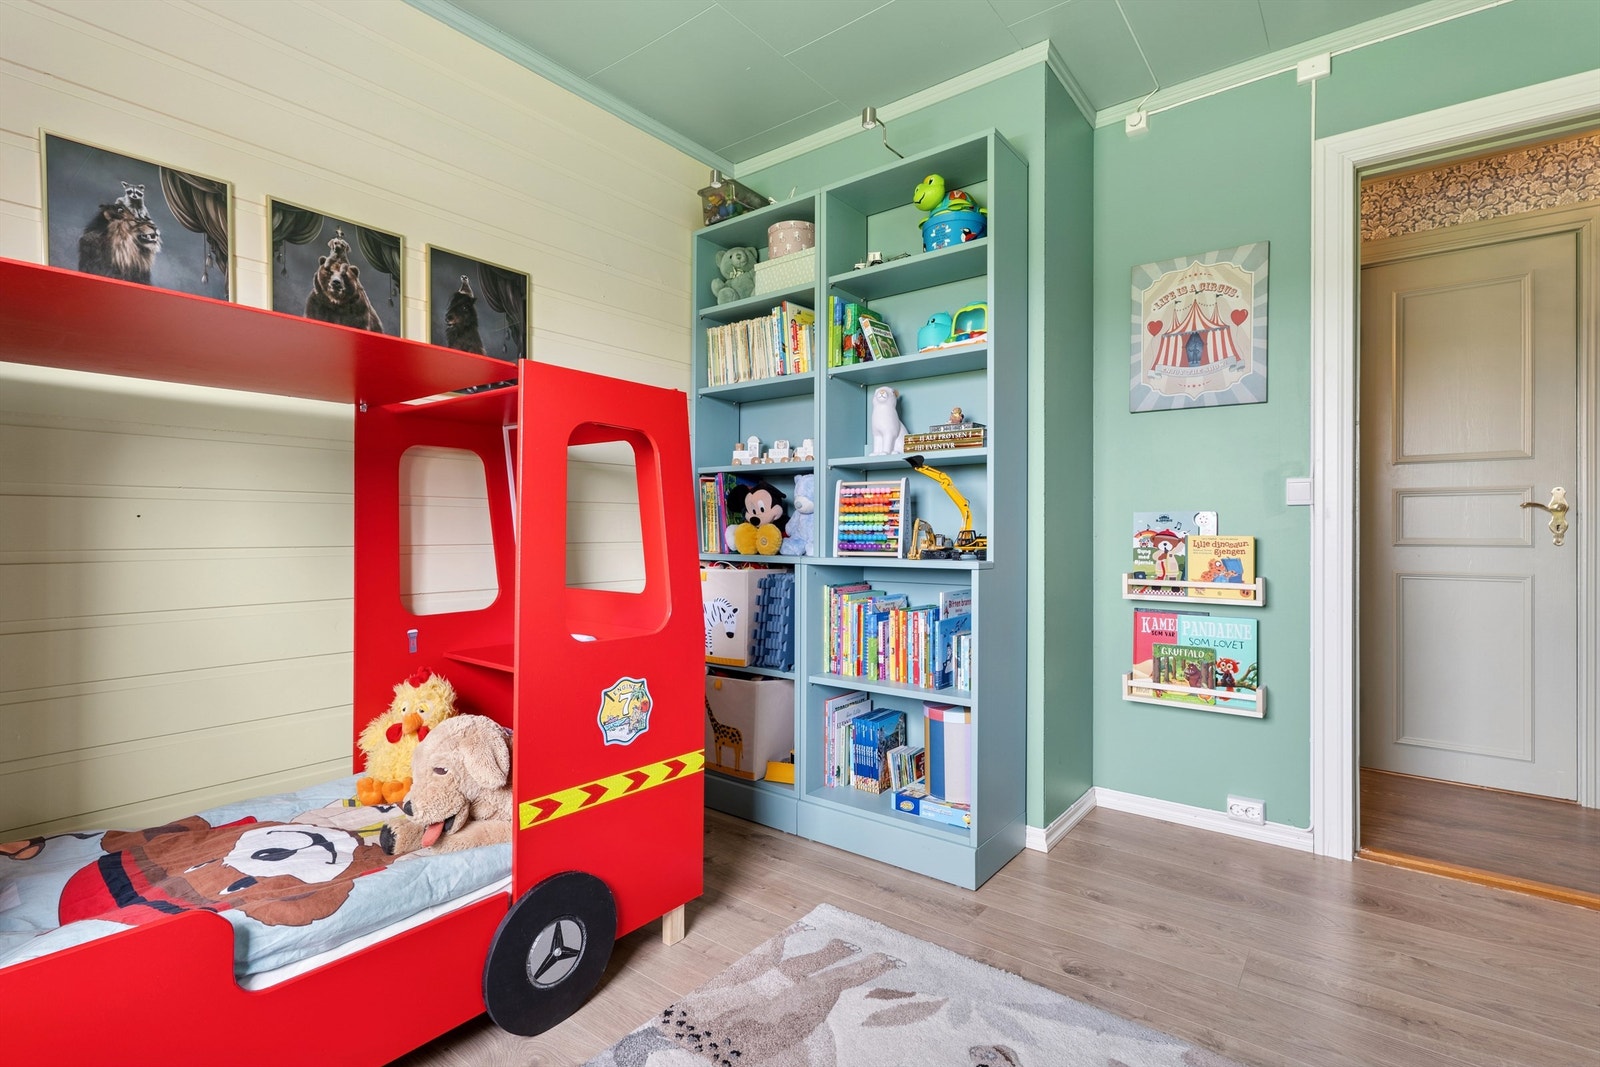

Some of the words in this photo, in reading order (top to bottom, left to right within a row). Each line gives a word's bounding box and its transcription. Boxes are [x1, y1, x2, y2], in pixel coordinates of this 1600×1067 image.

[1154, 291, 1177, 309] LIFE
[1176, 286, 1188, 297] IS
[1189, 284, 1197, 293] A
[1199, 282, 1238, 298] CIRCUS
[938, 432, 967, 440] PRØYSEN
[925, 442, 955, 450] EVENTYR
[1193, 540, 1211, 548] Lille
[1214, 549, 1246, 557] gjengen
[1182, 620, 1252, 640] PANDAENE
[1188, 637, 1210, 647] SOM
[1213, 640, 1244, 649] LOVET
[1161, 646, 1205, 659] GRUFFALO
[613, 684, 636, 696] ENGINE
[618, 691, 634, 716] 7
